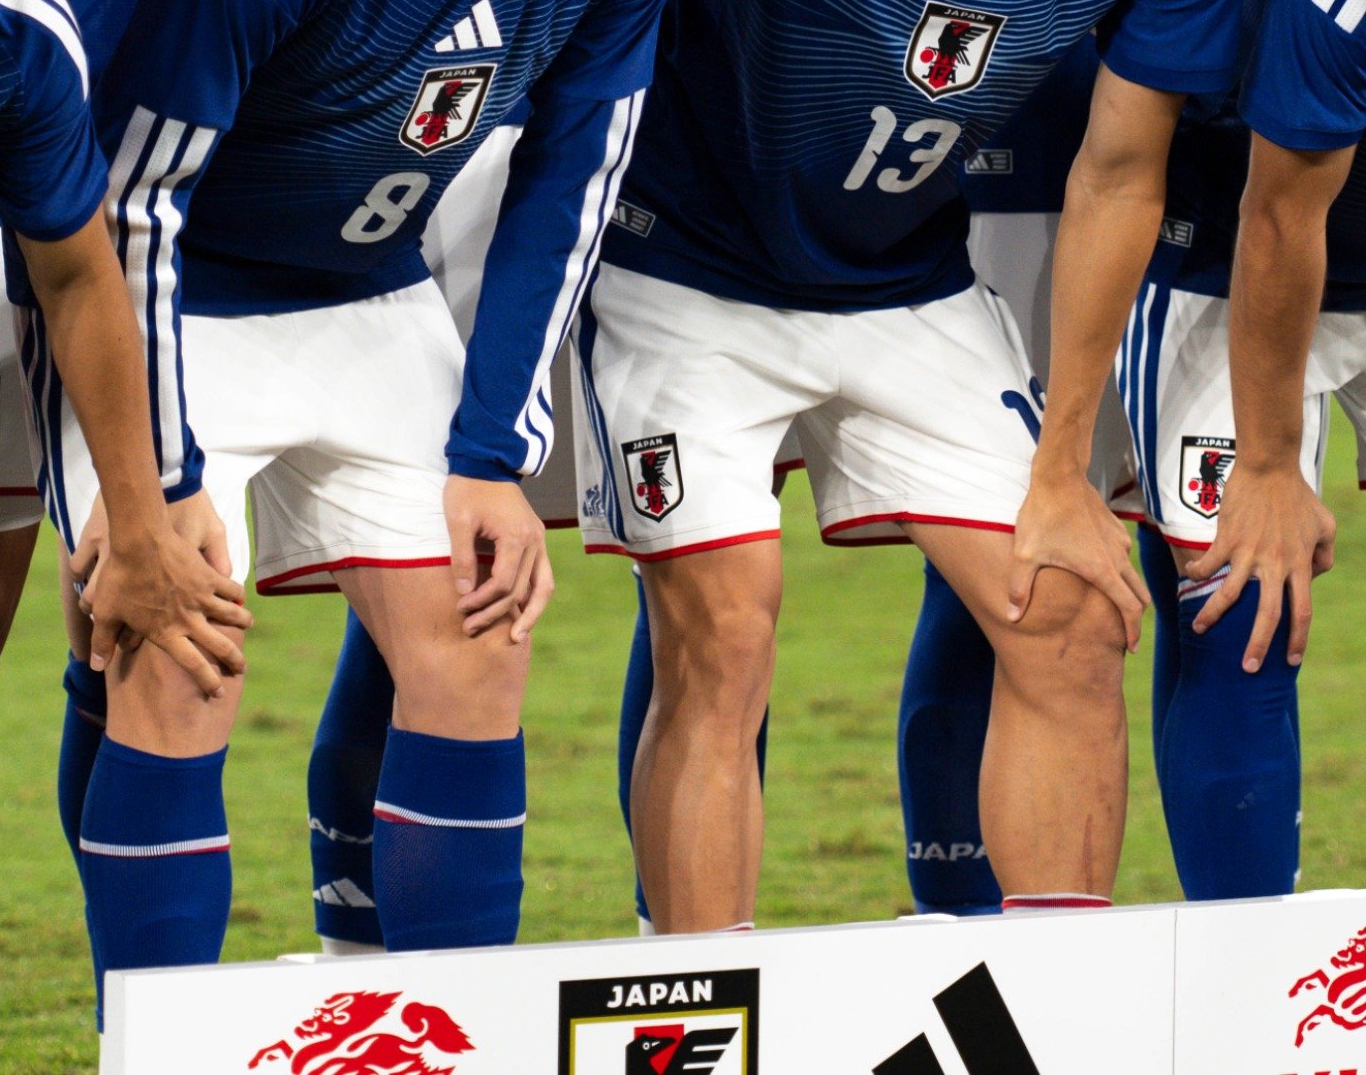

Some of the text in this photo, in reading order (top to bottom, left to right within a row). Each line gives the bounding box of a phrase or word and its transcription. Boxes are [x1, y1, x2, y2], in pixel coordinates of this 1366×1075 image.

[943, 8, 985, 23] JAPAN
[439, 68, 477, 79] JAPAN
[843, 106, 963, 193] 13
[340, 171, 431, 243] 8
[632, 438, 665, 452] JAPAN
[1195, 438, 1232, 449] JAPAN
[907, 841, 987, 863] JAPA
[607, 979, 714, 1009] JAPAN
